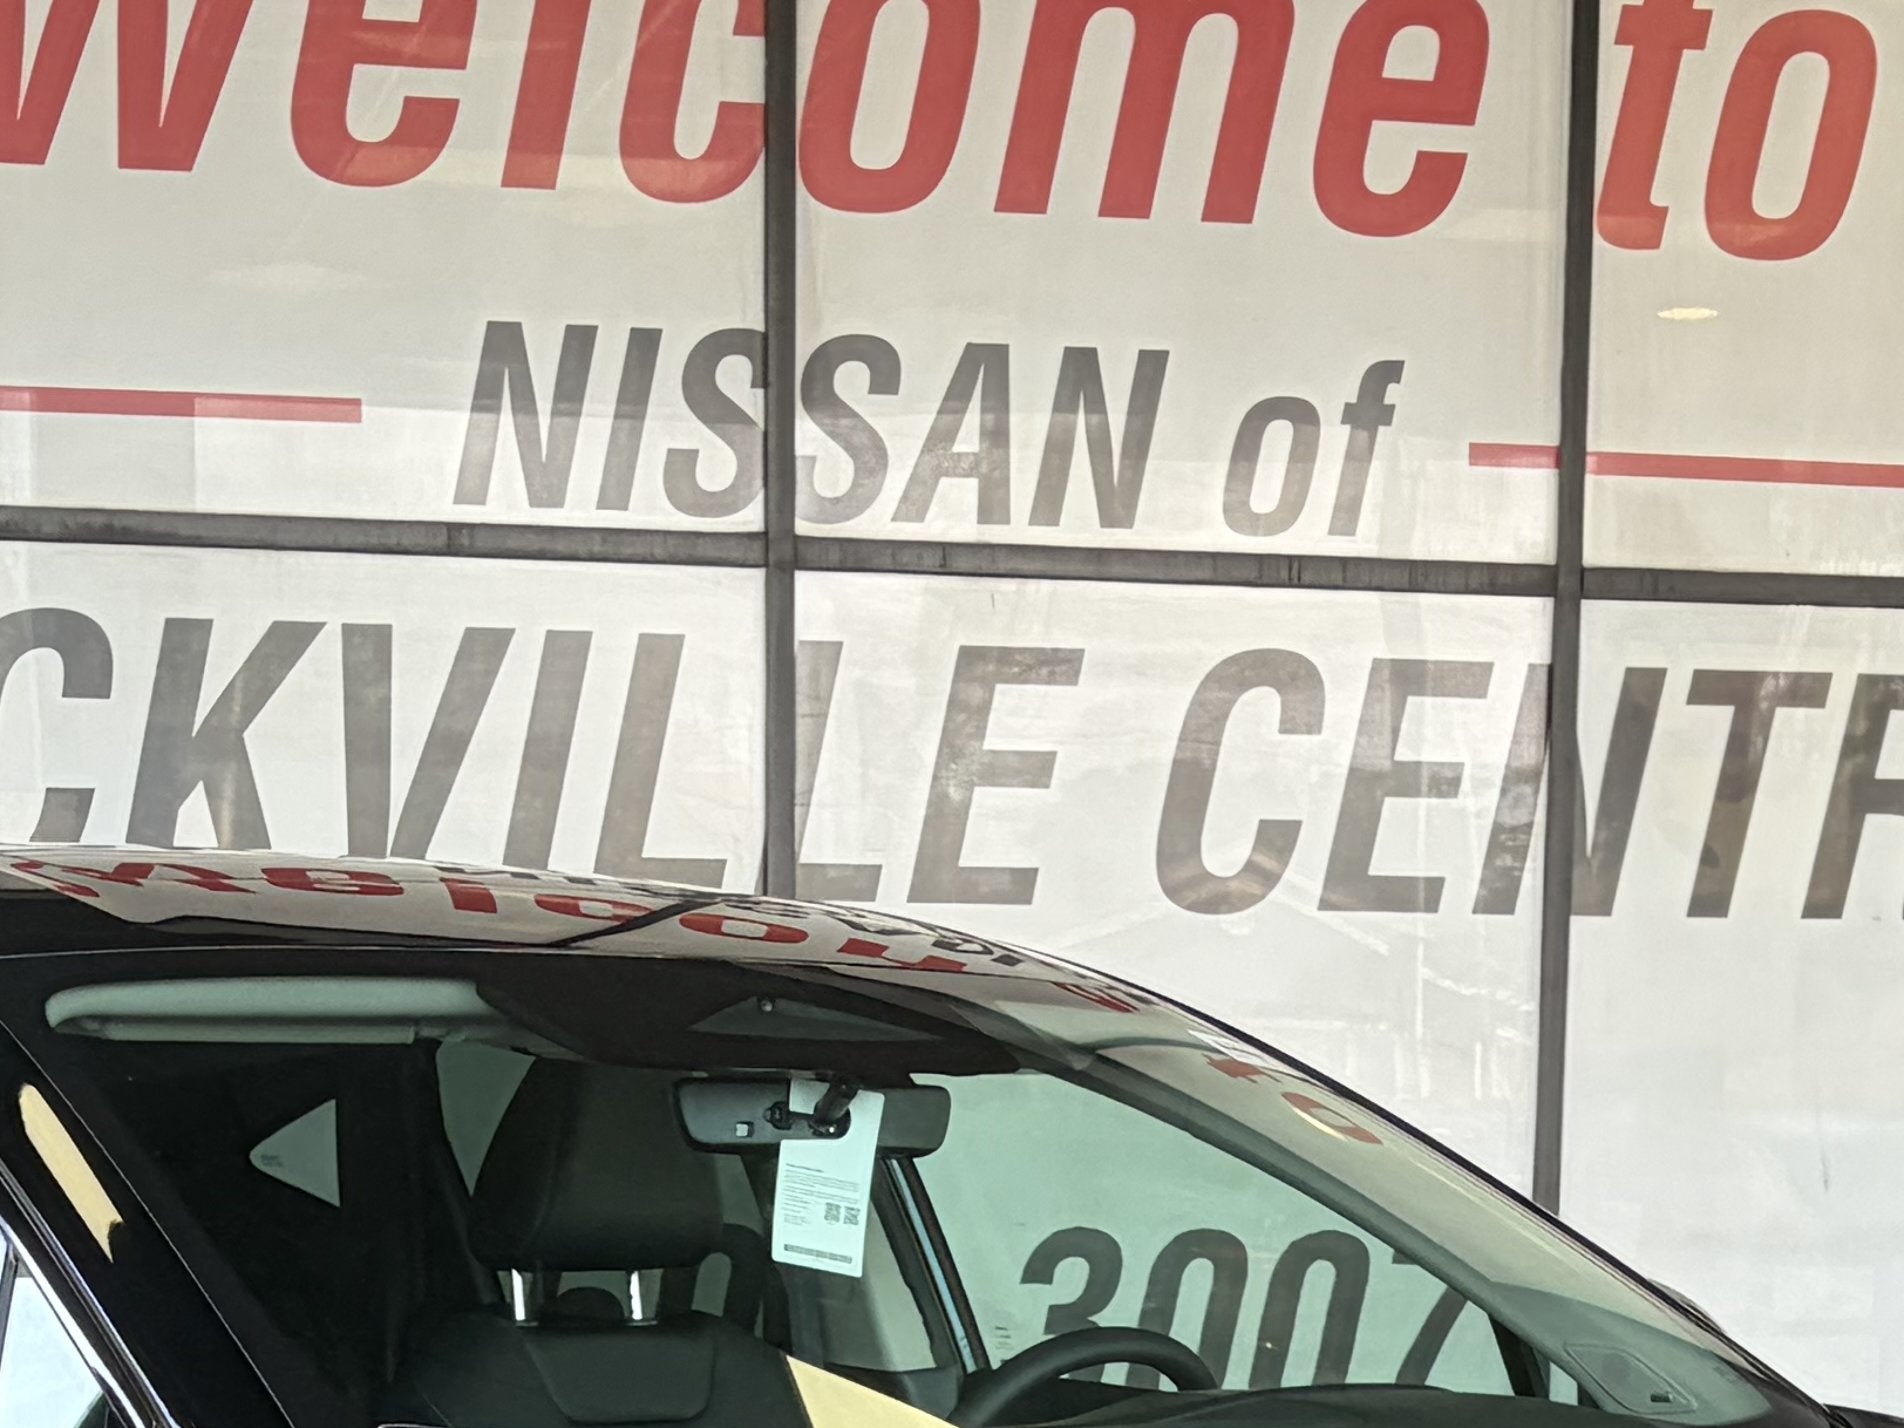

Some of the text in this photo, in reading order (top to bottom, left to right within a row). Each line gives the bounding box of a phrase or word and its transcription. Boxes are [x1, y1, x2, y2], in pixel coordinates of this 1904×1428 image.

[1596, 0, 1879, 262] to
[453, 320, 1405, 538] NISSAN of
